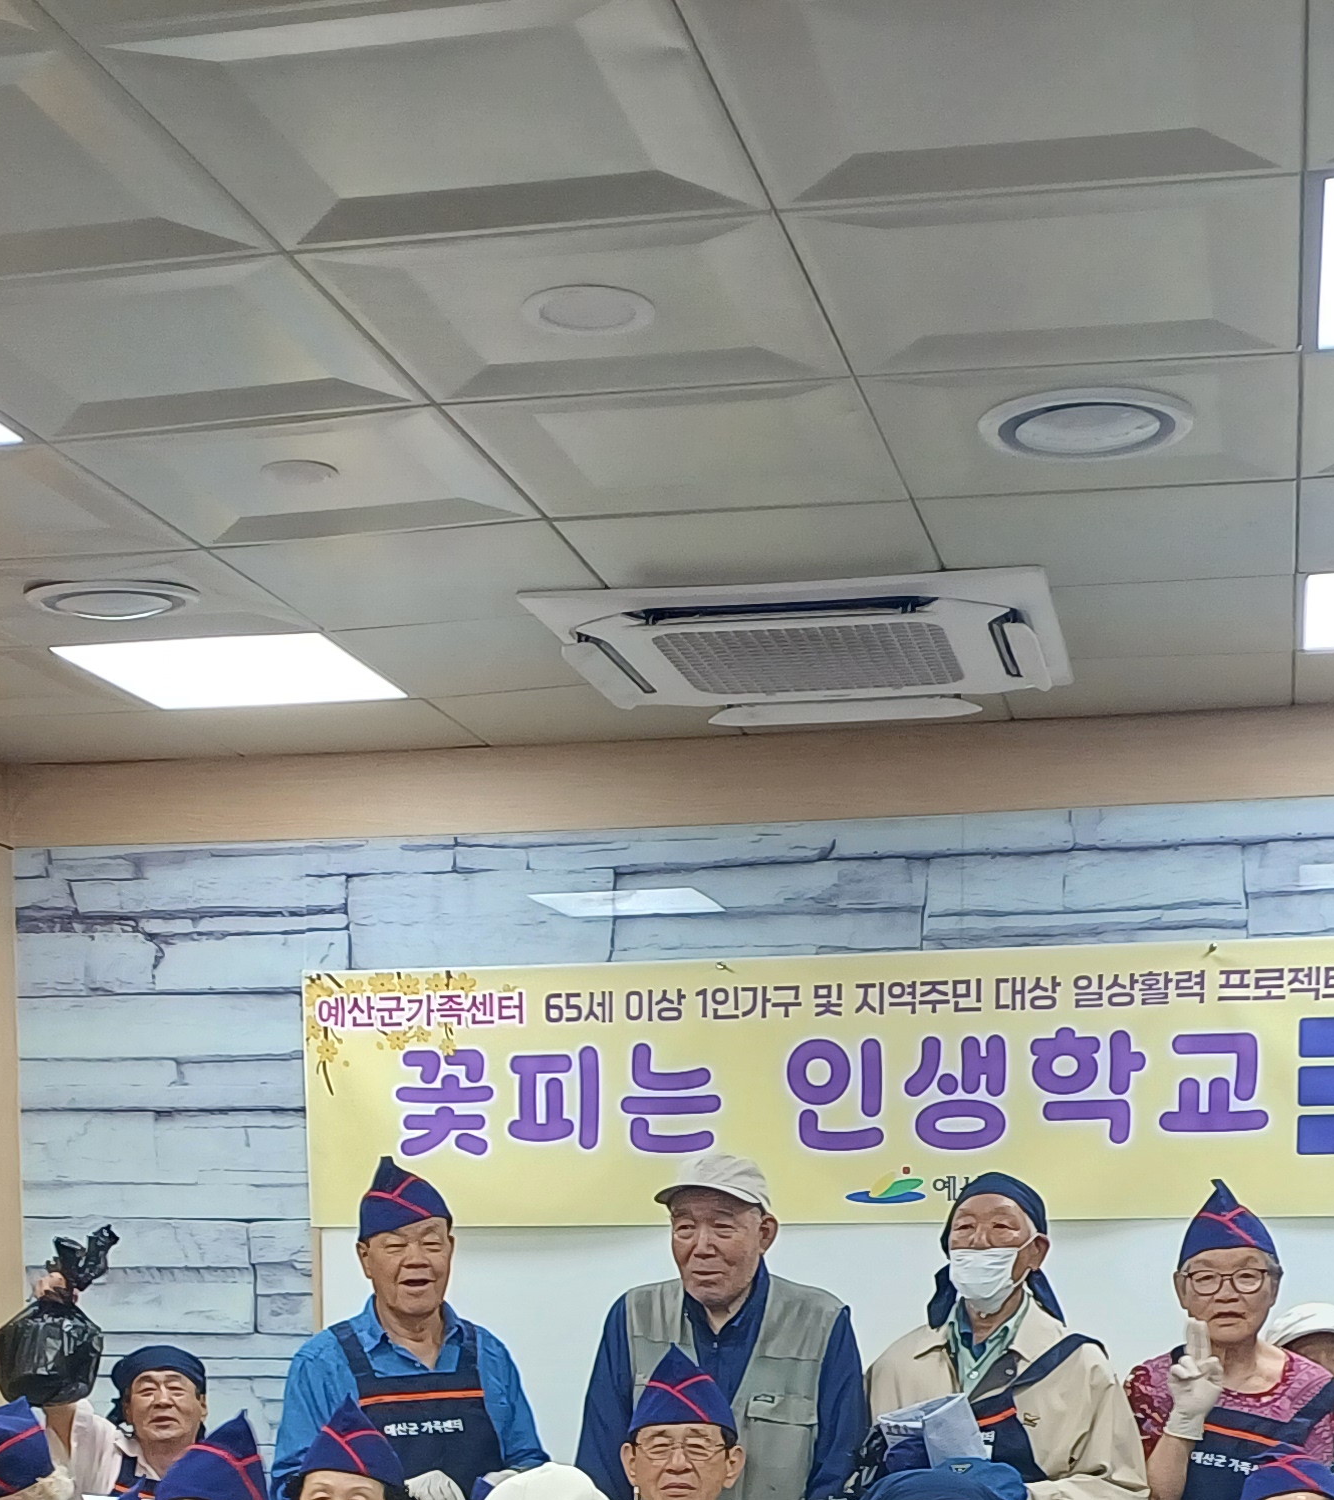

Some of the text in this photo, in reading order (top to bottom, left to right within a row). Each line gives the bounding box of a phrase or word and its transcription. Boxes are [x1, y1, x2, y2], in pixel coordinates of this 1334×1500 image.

[318, 991, 524, 1027] 예산군가족센터
[545, 990, 614, 1023] 65세
[625, 988, 686, 1022] 이상
[695, 985, 802, 1020] 1인가구
[814, 983, 843, 1017] 및
[855, 978, 982, 1015] 지역주민
[995, 975, 1062, 1011] 대상
[1073, 969, 1206, 1008] 일상활력
[395, 1027, 1270, 1157] 꽃피는 인생학교
